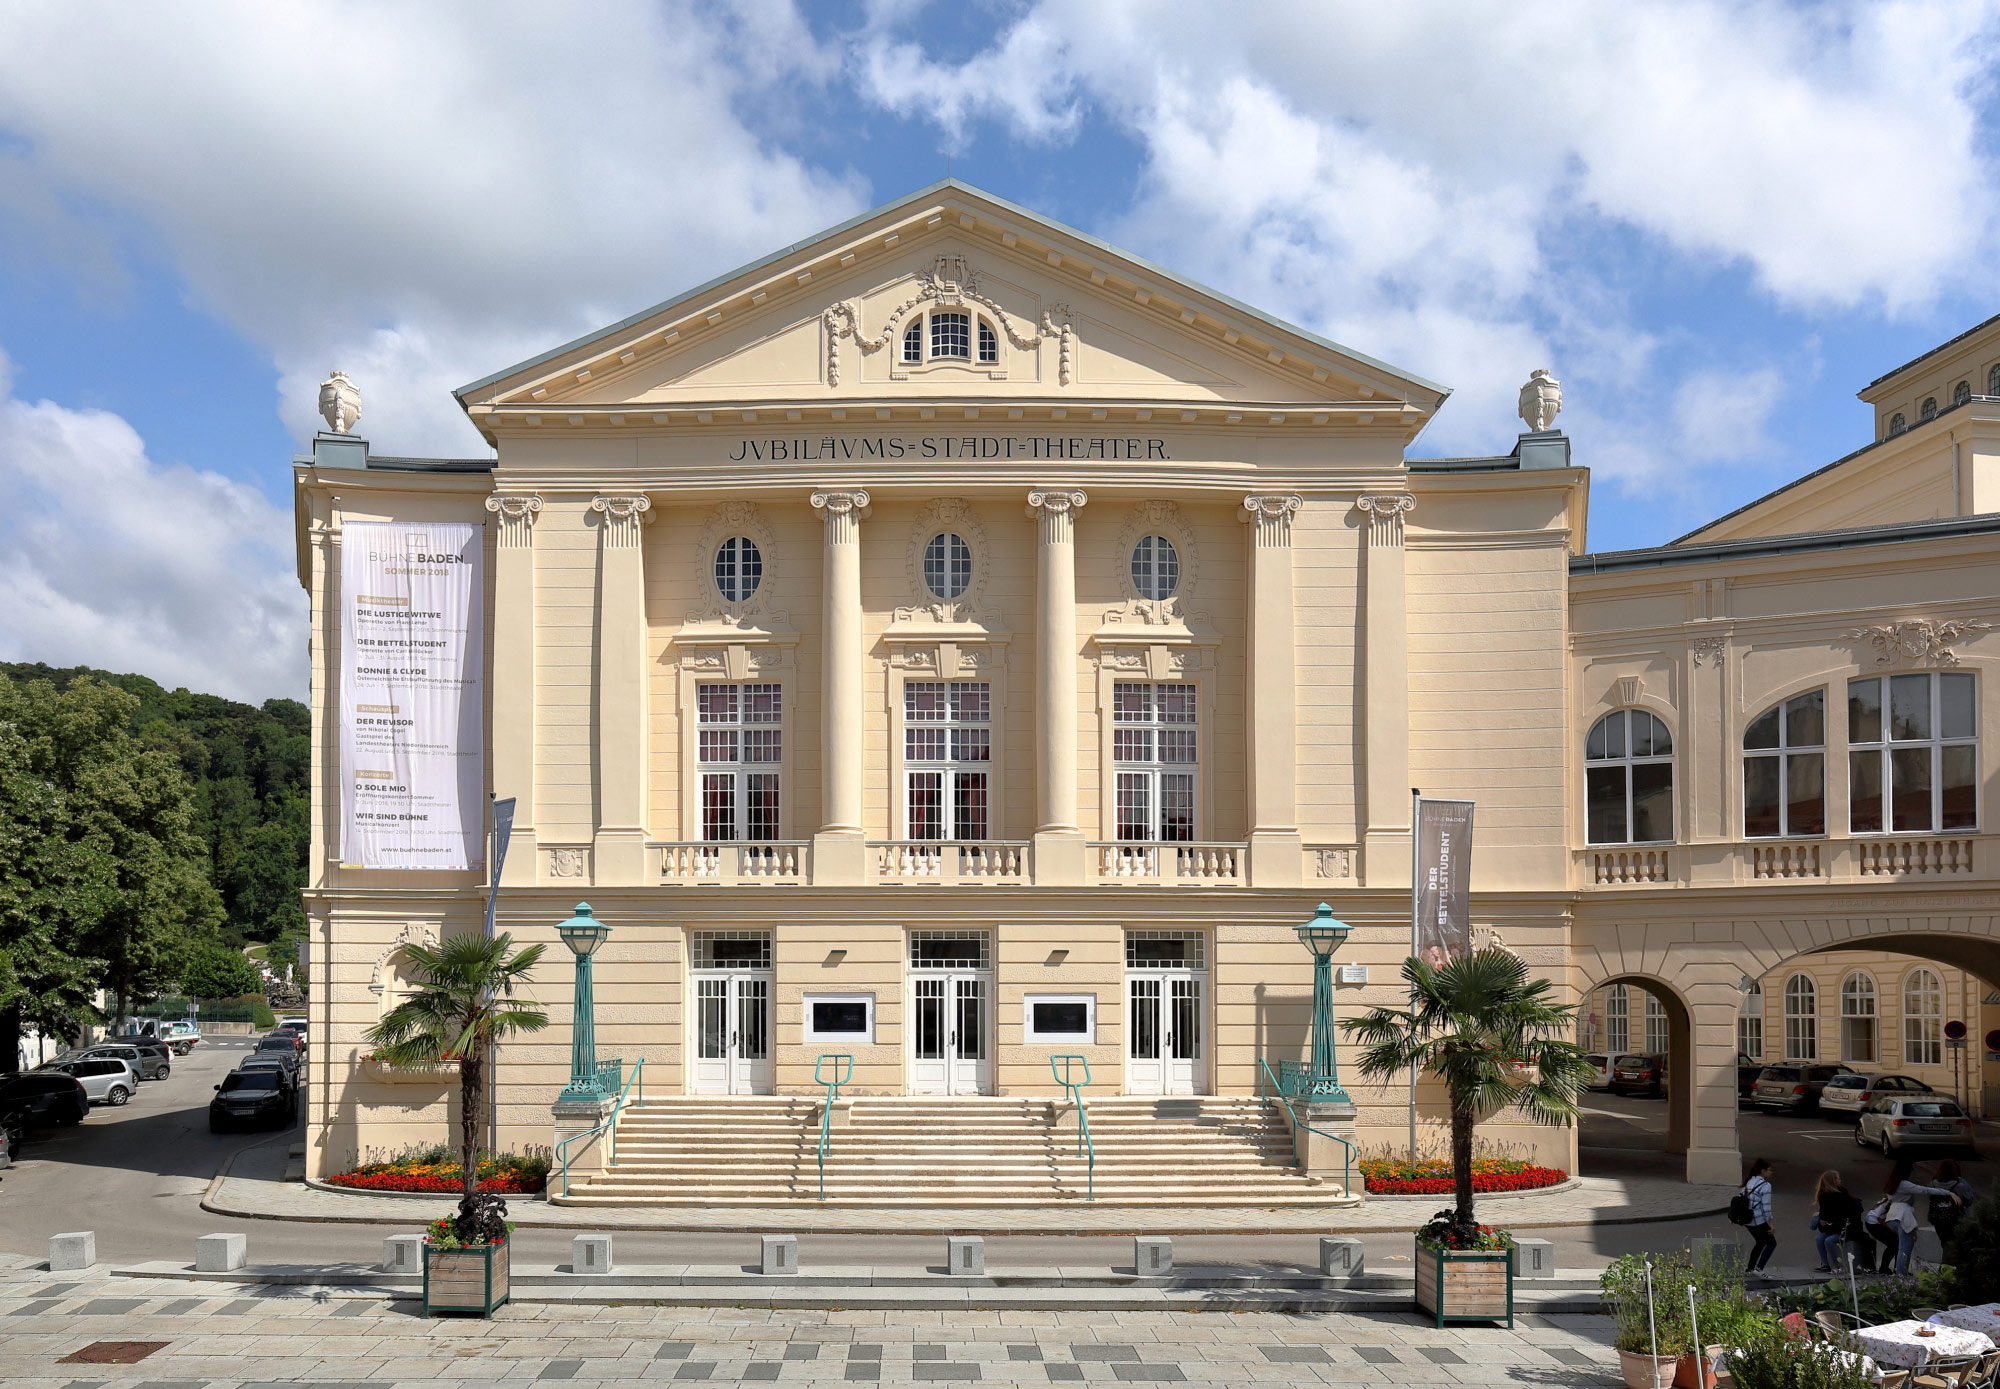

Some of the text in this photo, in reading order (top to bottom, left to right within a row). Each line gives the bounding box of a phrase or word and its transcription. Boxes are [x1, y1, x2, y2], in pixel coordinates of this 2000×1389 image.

[369, 550, 464, 564] BÜHNE BADEN
[384, 567, 450, 576] SOMMER 2018
[357, 609, 442, 619] DIE LUSTIGE WITWE
[357, 638, 448, 648] DER BETTELSTUDENT
[357, 666, 391, 675] BONNIE
[399, 668, 427, 676] CLYDE
[361, 704, 395, 713] Schauspi
[364, 784, 387, 792] SOLE
[355, 812, 374, 820] WIR
[399, 812, 429, 821] BÜHNE
[380, 846, 452, 854] www.buehnebaden.at
[1428, 867, 1438, 891] DER
[1438, 831, 1450, 925] BETTELSTUDENT
